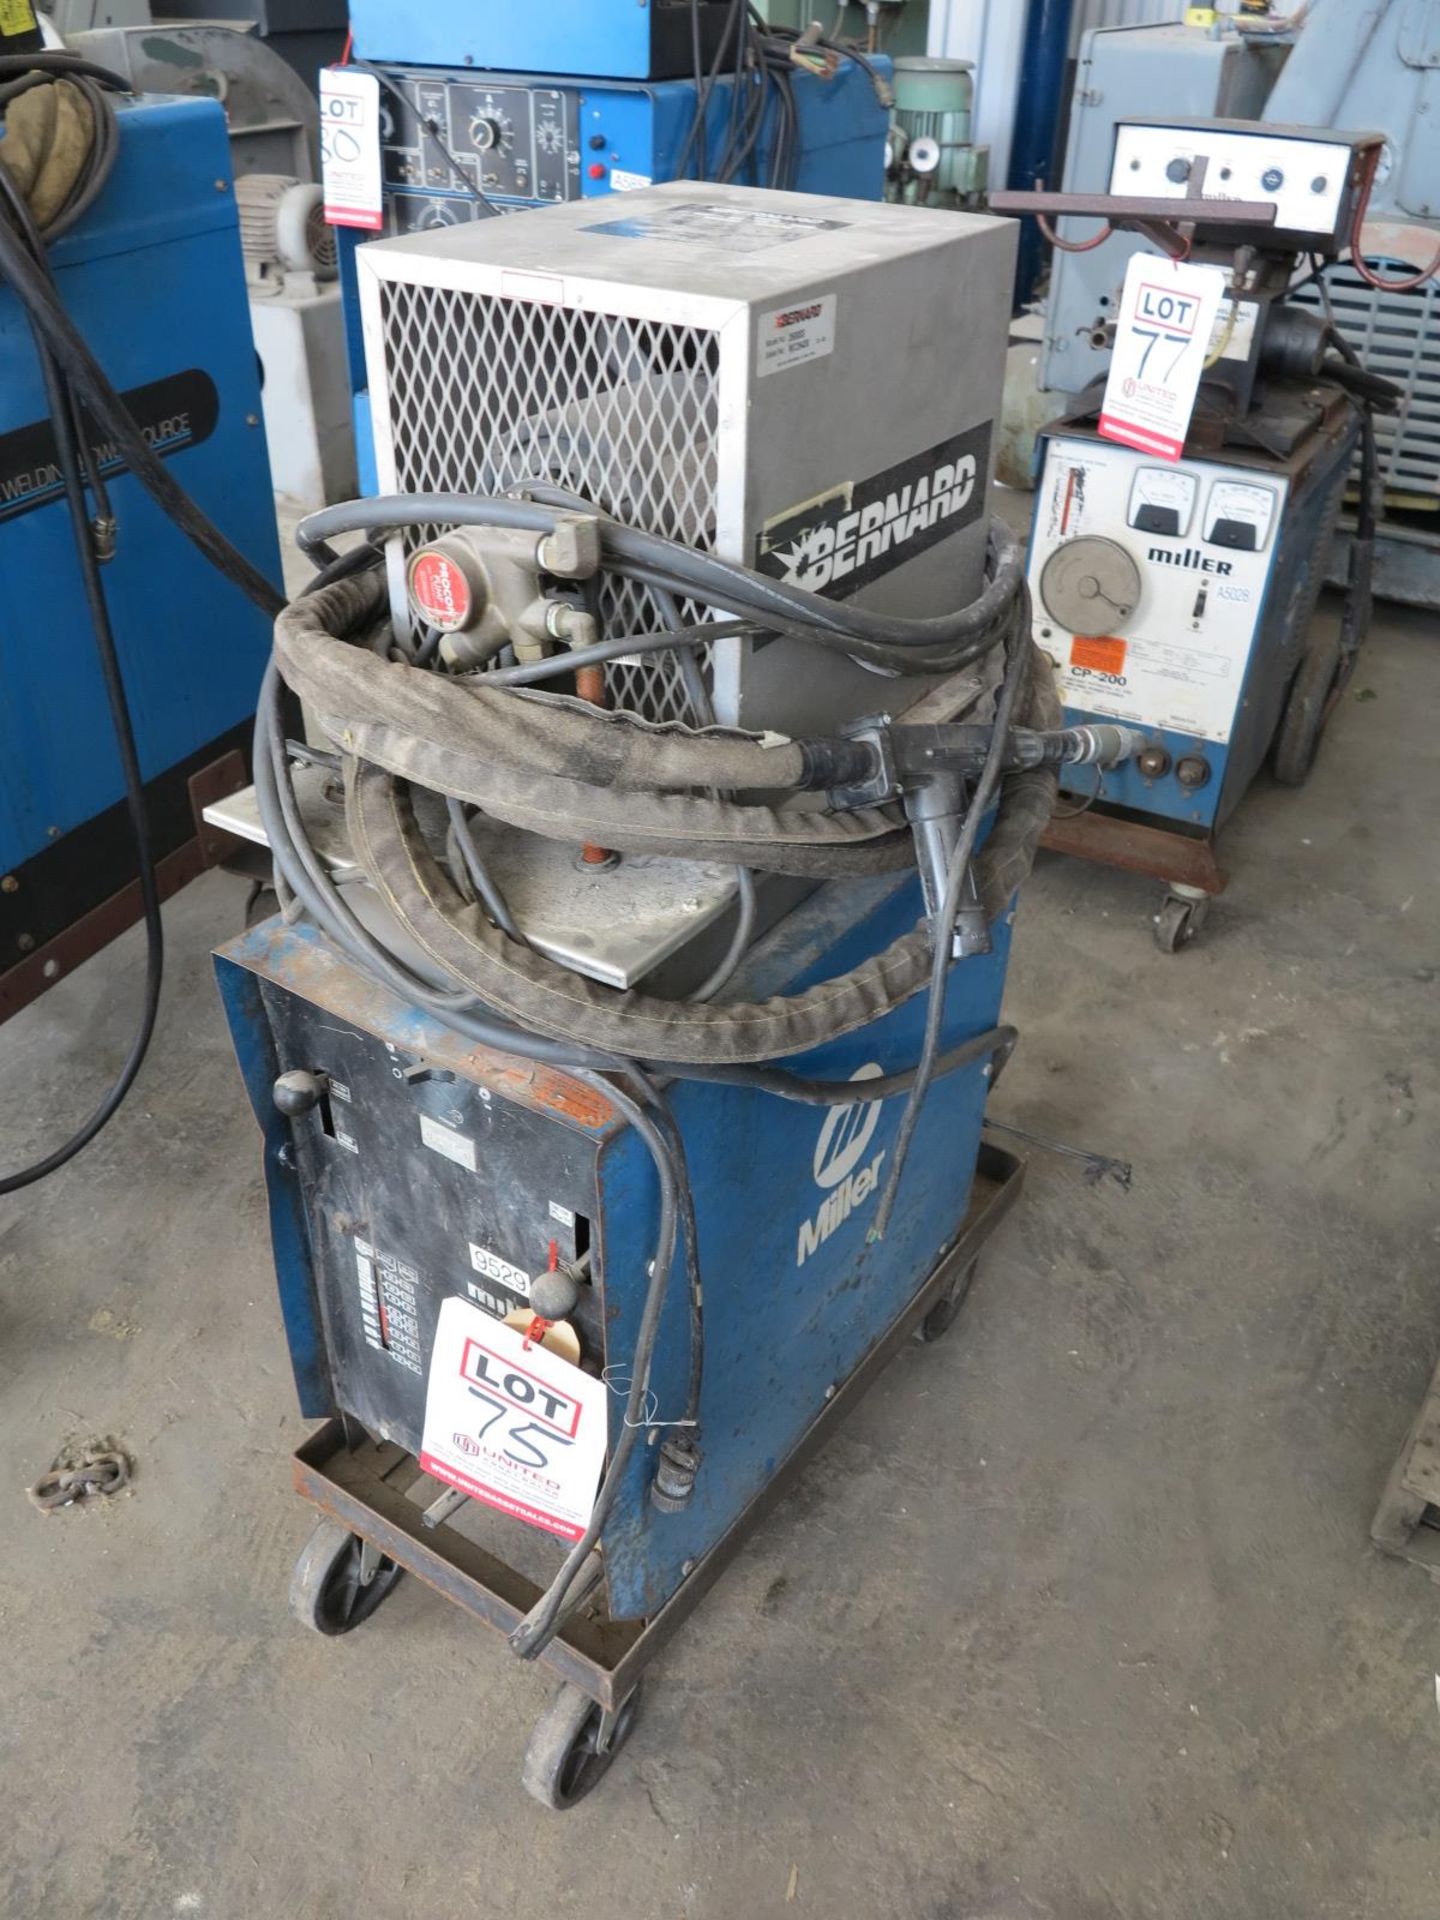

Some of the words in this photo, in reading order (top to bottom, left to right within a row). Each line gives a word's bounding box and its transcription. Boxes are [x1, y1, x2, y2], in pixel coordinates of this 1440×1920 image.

[778, 304, 823, 328] BERNARD
[1143, 292, 1192, 324] LOT
[1131, 326, 1192, 385] 77
[1, 463, 64, 500] WELDIN
[797, 454, 977, 594] BERNARD
[438, 562, 455, 617] PROCON
[1071, 666, 1128, 687] CP-200
[797, 1150, 886, 1268] Miller
[475, 1250, 527, 1292] 9529
[475, 1353, 568, 1420] LOT
[468, 1385, 577, 1469] 75
[482, 1445, 561, 1491] UNITED
